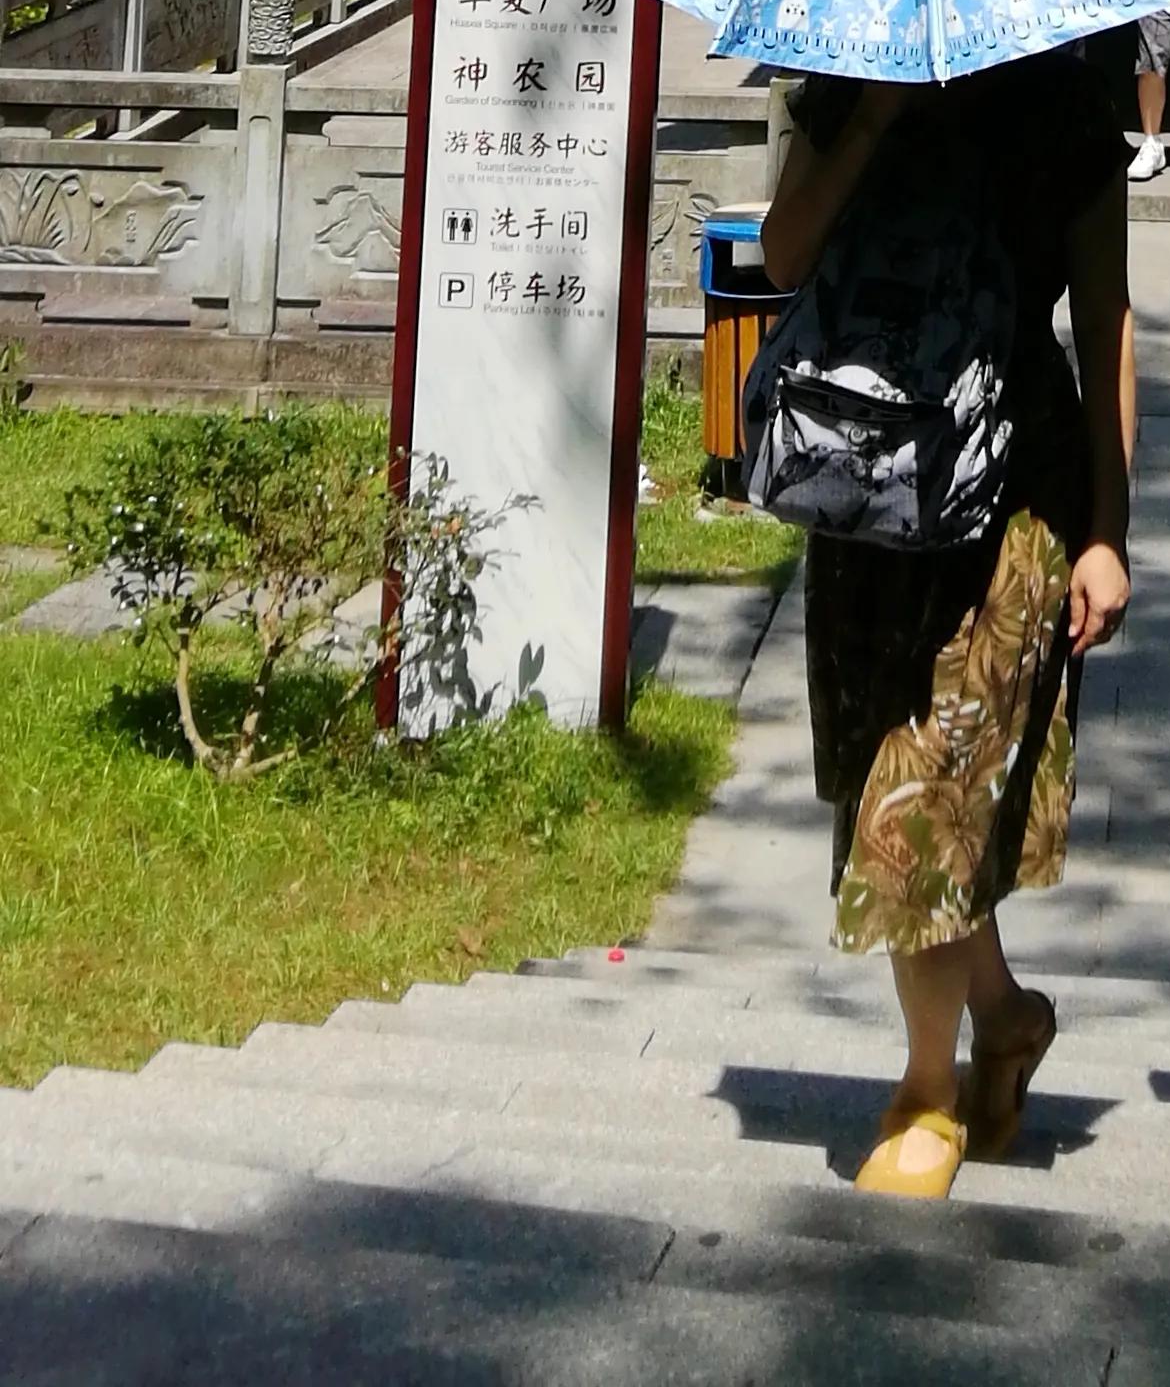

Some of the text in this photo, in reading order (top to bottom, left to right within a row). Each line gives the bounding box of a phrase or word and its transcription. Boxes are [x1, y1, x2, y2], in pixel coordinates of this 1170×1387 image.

[484, 19, 518, 30] Square
[453, 56, 606, 95] 神农园
[445, 94, 479, 105] Garden
[480, 95, 490, 105] of
[444, 129, 608, 159] 游客服务中心
[475, 161, 575, 175] Tourist Service Center
[490, 207, 588, 240] 洗手间
[491, 241, 514, 252] Toilet
[447, 279, 465, 302] P
[487, 271, 585, 305] 停车场
[483, 303, 518, 316] Parking
